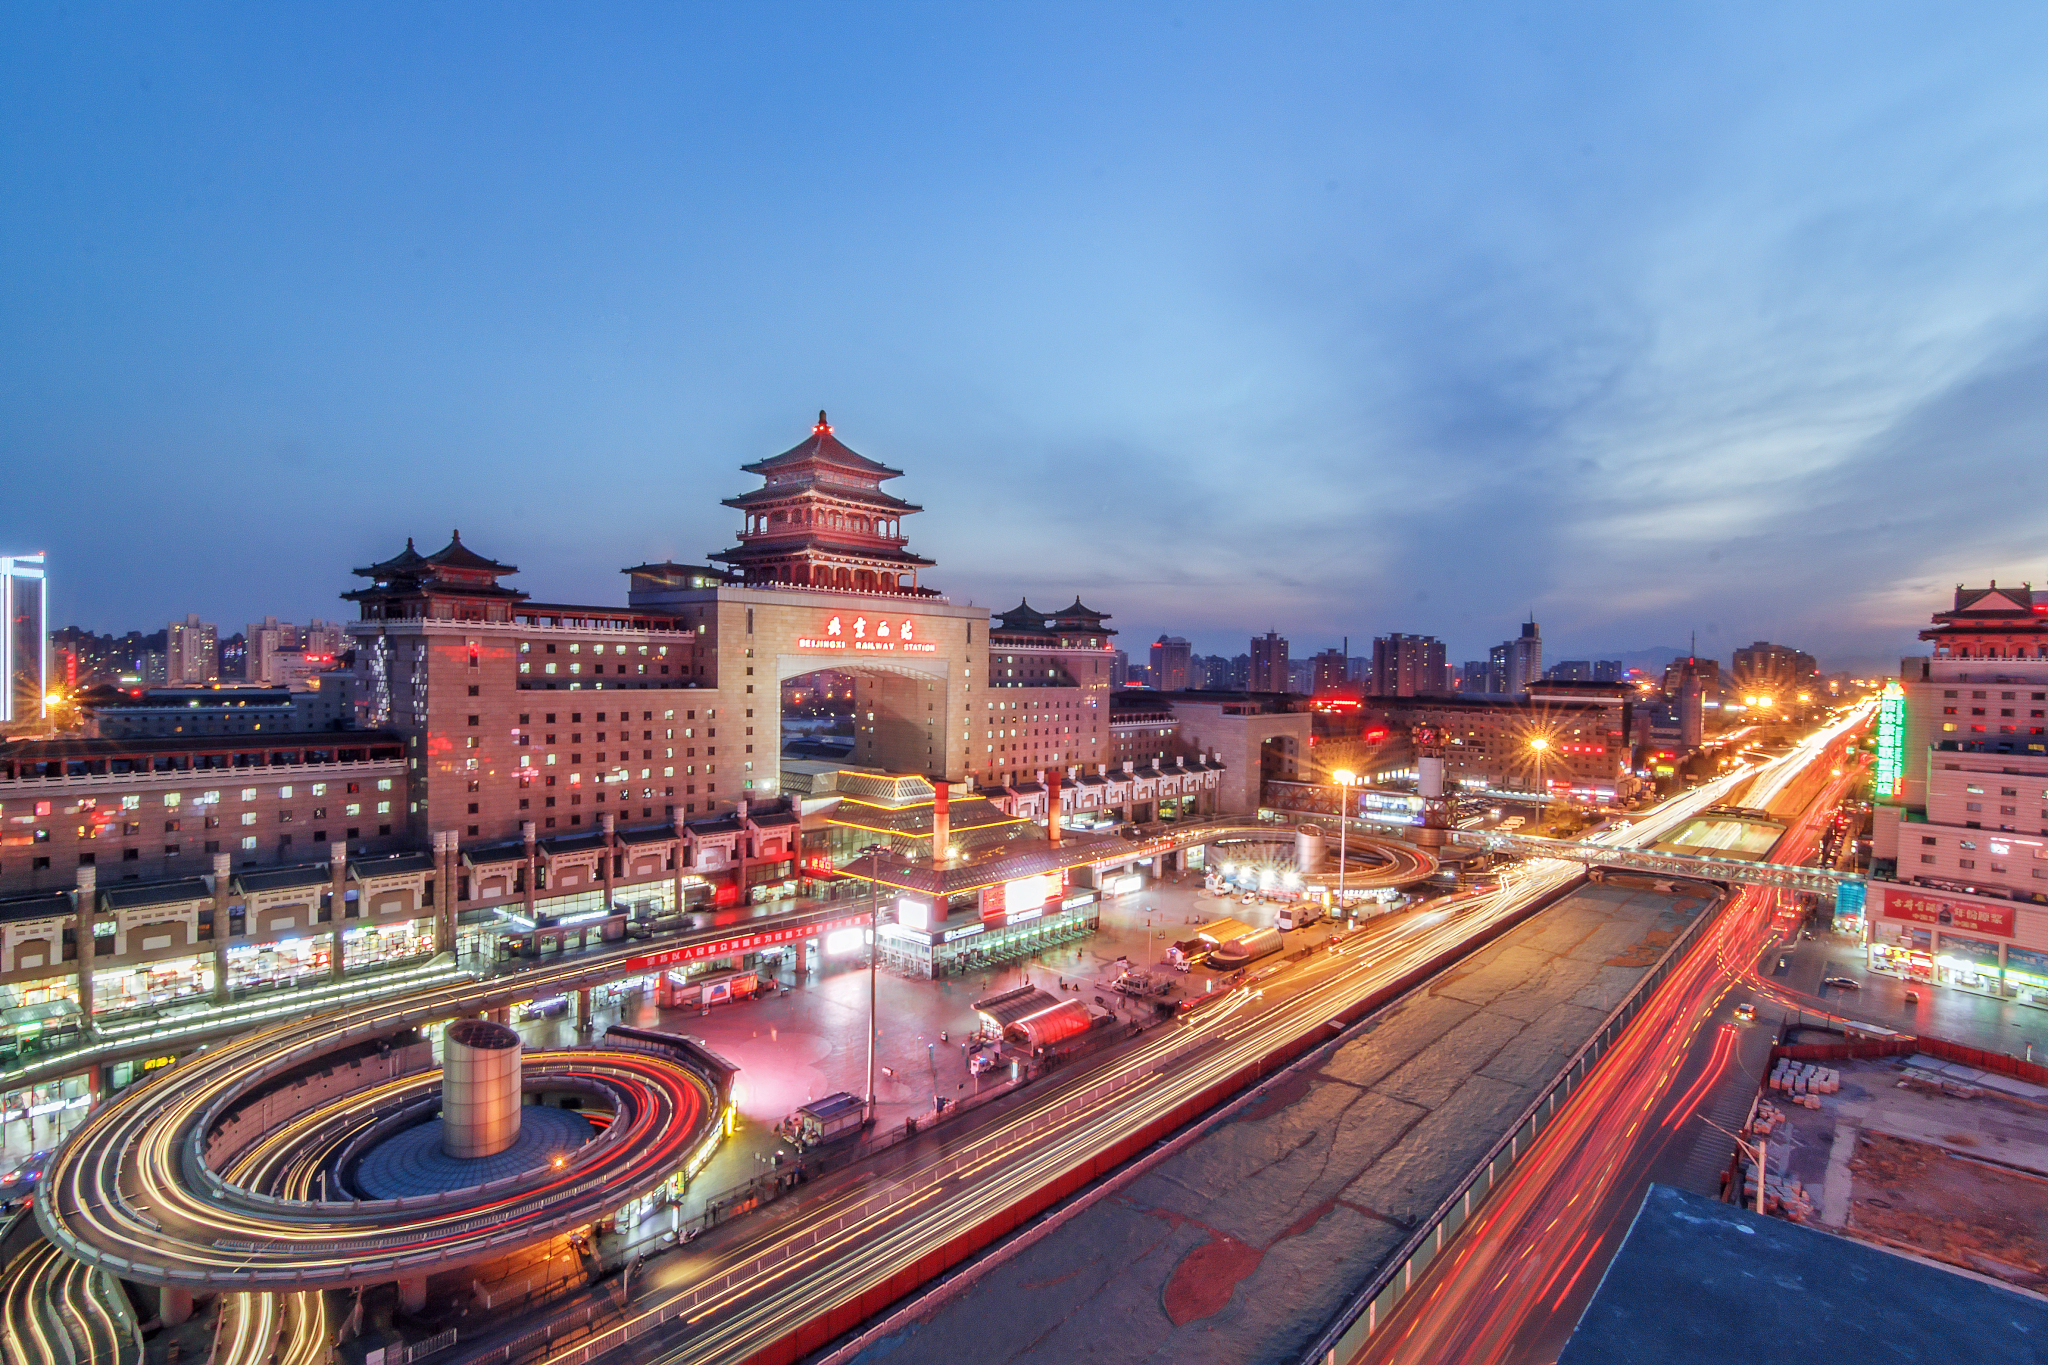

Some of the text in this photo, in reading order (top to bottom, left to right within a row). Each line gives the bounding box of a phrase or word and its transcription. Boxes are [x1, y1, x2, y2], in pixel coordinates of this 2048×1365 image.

[828, 616, 912, 641] 北京西站
[799, 639, 935, 652] BEIJINGXI RAILWAY STATION
[1891, 898, 1936, 913] 古井贡酒
[1954, 907, 2003, 925] 年份原浆
